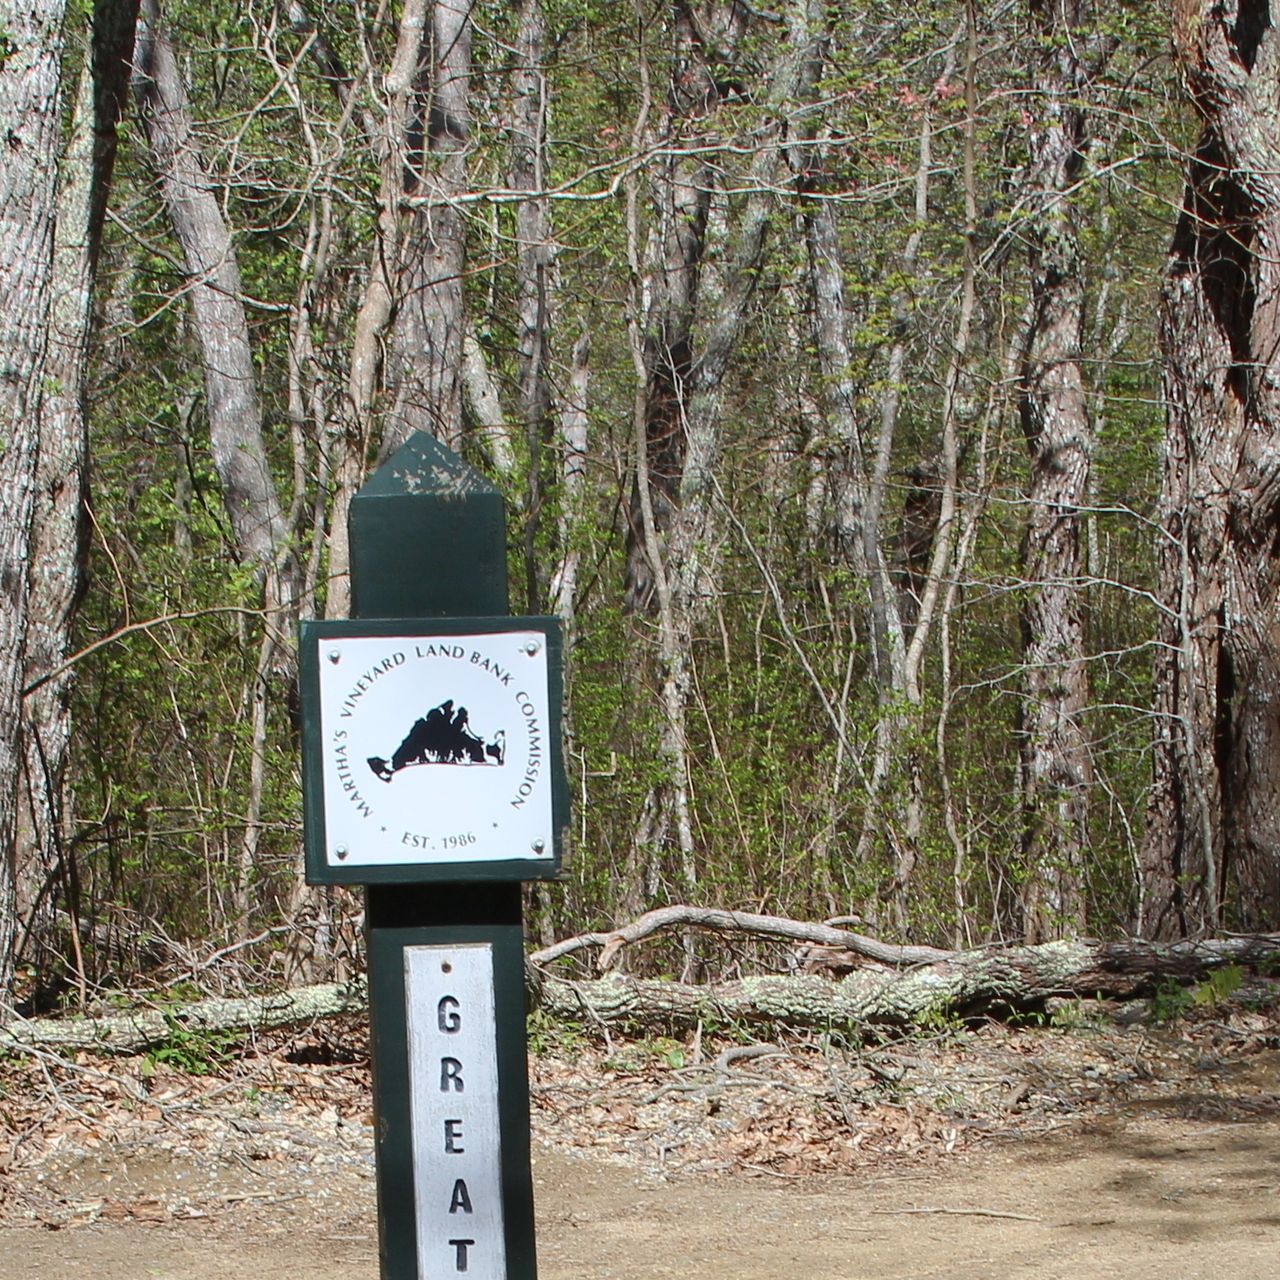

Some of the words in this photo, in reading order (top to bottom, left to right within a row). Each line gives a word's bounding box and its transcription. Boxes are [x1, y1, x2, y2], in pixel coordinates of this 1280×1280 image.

[415, 643, 465, 660] LAND
[470, 652, 515, 686] BANK
[340, 652, 406, 719] VINEYARD
[334, 730, 373, 818] MARTHA'S
[511, 691, 541, 809] COMMISSION
[401, 831, 436, 851] EST.
[442, 831, 477, 850] 1986
[436, 994, 476, 1273] GREAT
